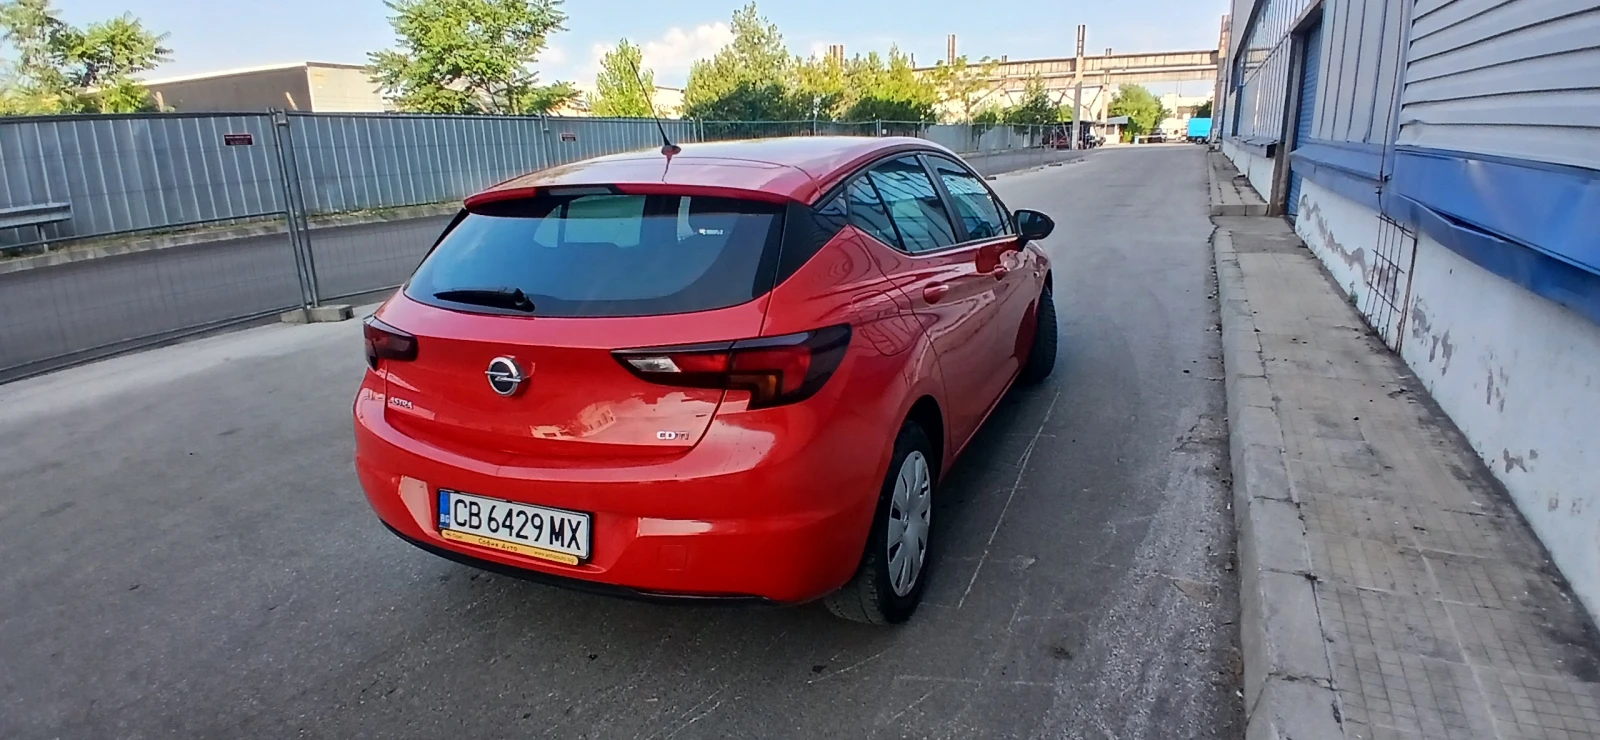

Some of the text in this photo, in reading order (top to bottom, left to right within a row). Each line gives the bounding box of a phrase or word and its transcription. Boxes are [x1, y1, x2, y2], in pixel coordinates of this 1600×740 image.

[389, 396, 413, 409] ASTRA
[440, 513, 450, 524] BG
[454, 498, 582, 551] CB 6429 MX
